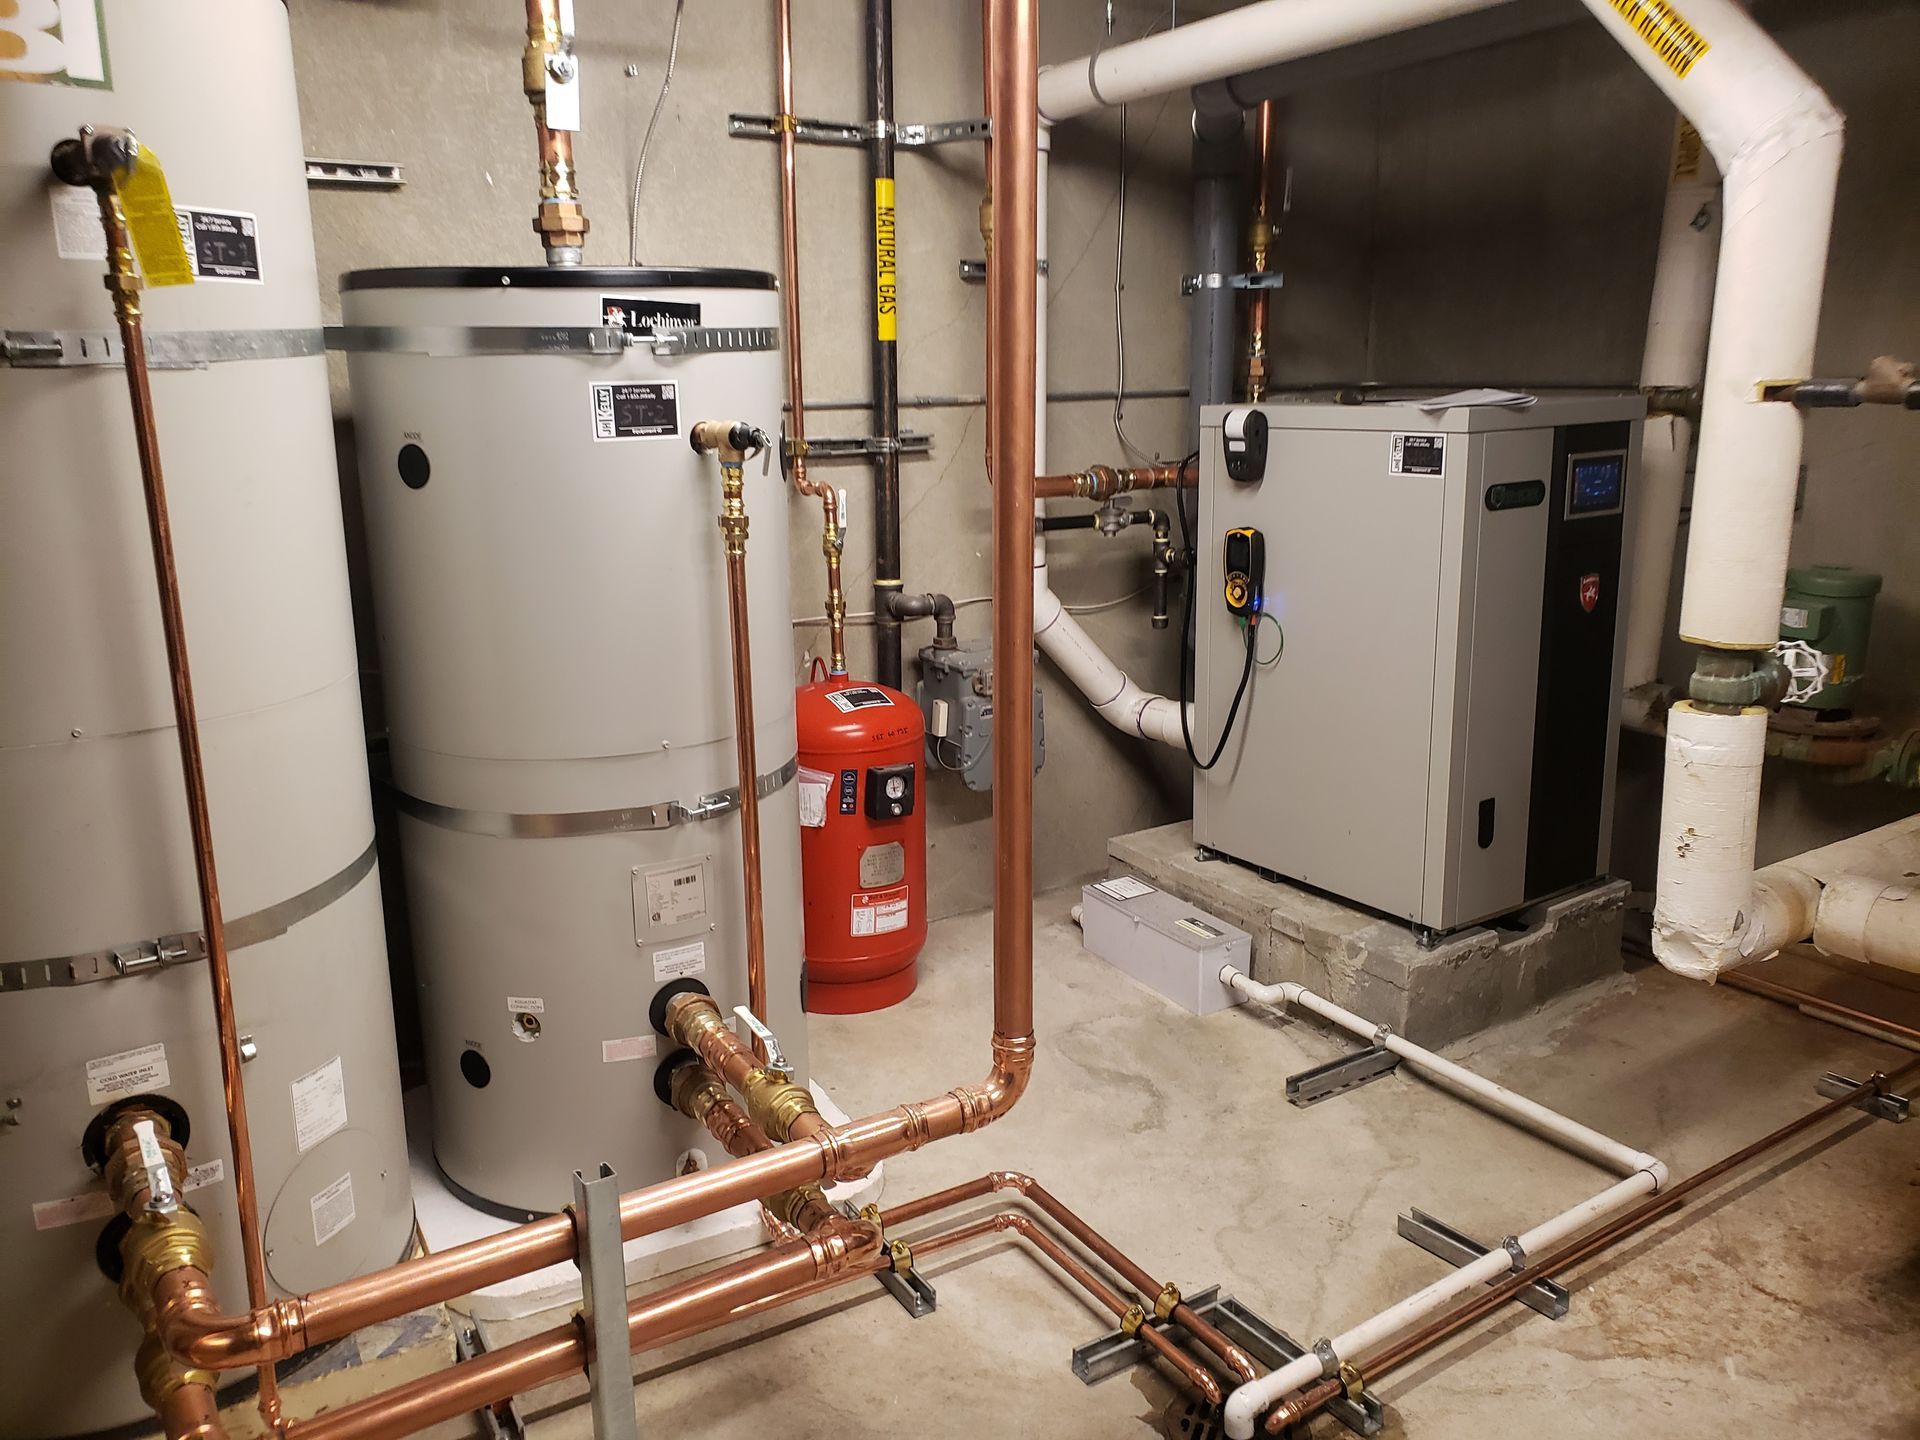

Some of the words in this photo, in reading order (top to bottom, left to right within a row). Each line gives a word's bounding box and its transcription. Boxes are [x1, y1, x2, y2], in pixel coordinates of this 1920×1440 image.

[878, 206, 896, 278] NATURAL
[879, 284, 896, 315] GAS
[630, 309, 698, 328] Lochinvar
[620, 403, 668, 425] ST-2
[99, 1074, 118, 1084] COLD
[119, 1070, 138, 1079] WATER
